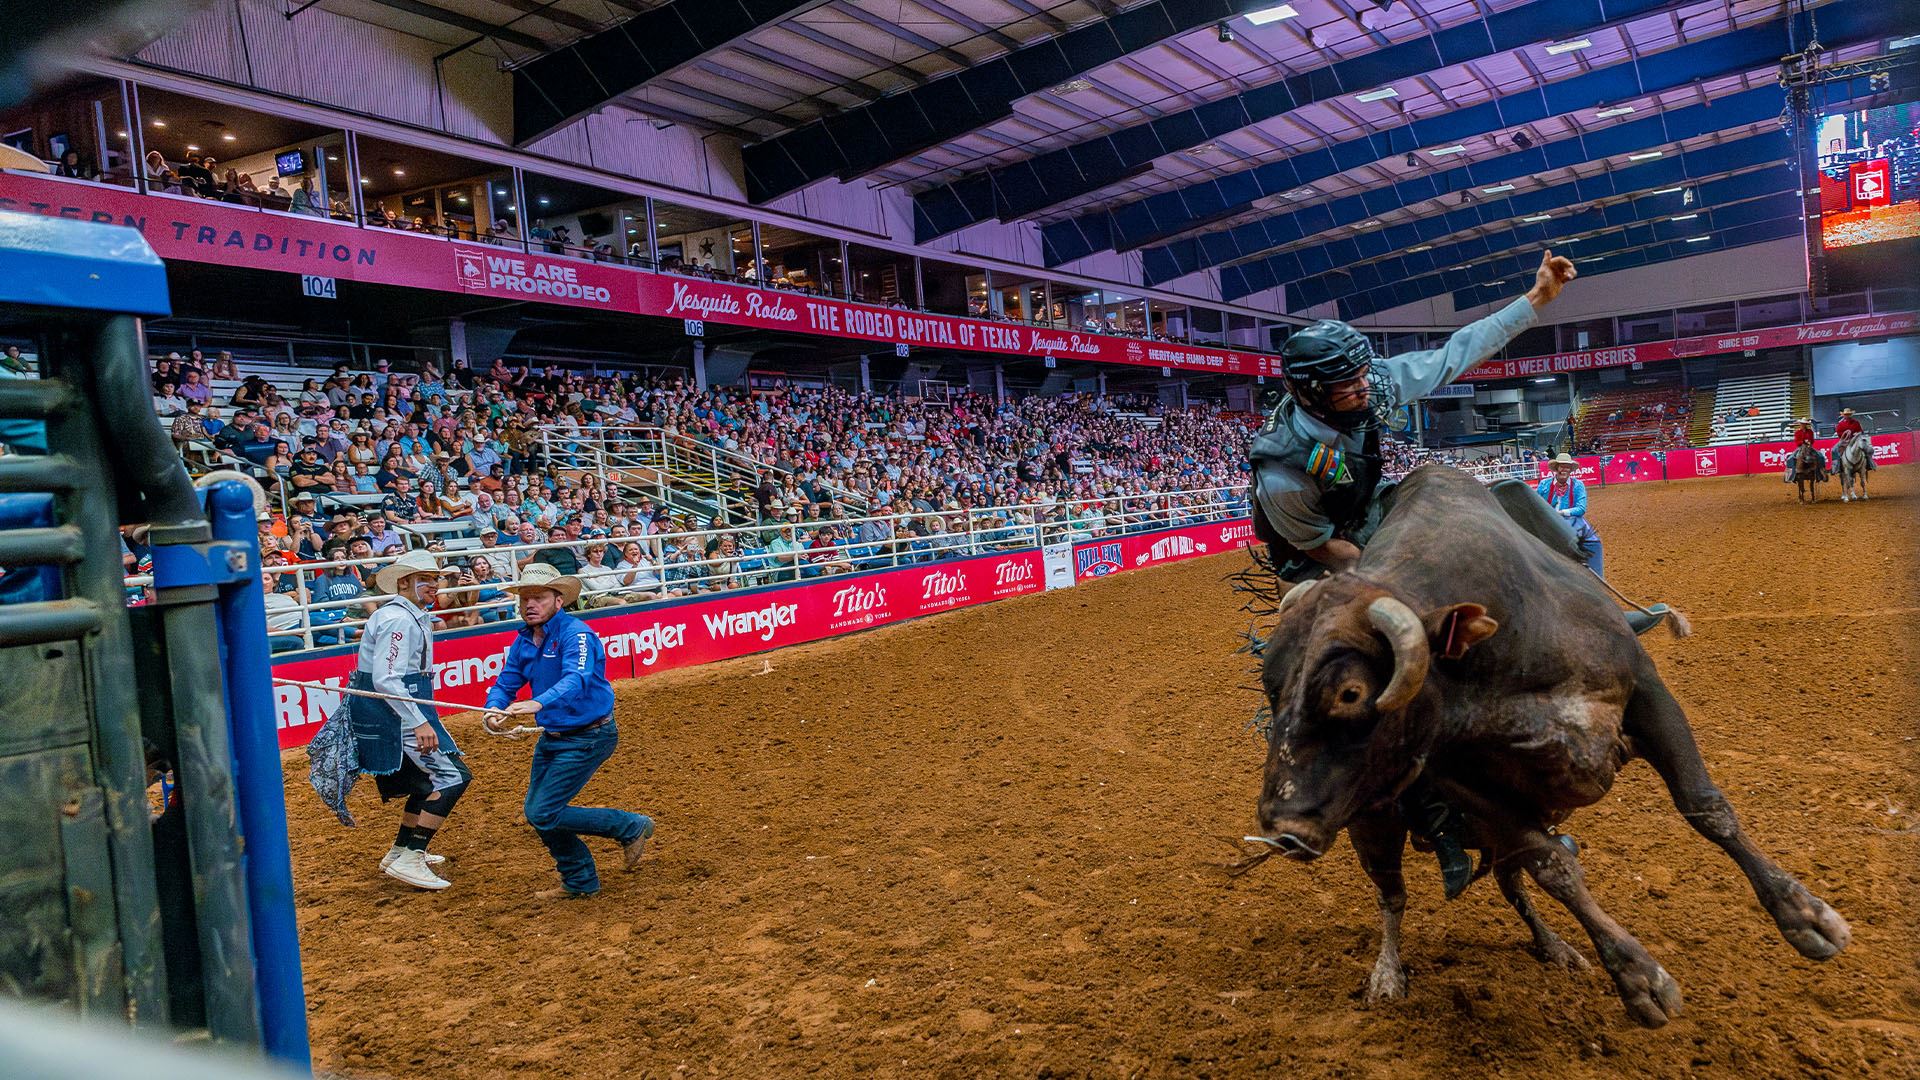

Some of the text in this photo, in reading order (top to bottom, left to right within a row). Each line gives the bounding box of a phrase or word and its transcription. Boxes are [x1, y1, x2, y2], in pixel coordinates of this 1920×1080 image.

[171, 221, 376, 266] TRADITION
[487, 256, 578, 283] WE ARE
[304, 277, 336, 297] 104
[489, 273, 611, 303] PRORODEO
[666, 282, 741, 318] Mesquite
[745, 292, 798, 321] Rodeo
[806, 302, 840, 331] THE
[844, 308, 894, 338] RODEO
[898, 316, 957, 345] CAPITAL
[959, 323, 976, 346] OF
[980, 326, 1021, 350] TEXAS
[1028, 330, 1068, 355] Mesquite
[1070, 335, 1100, 354] Rodeo
[686, 320, 703, 336] 106
[1796, 326, 1833, 340] Where
[1837, 317, 1887, 338] Legends
[1718, 335, 1759, 349] SINCE 1957
[1148, 349, 1185, 366] HERITAGE
[1186, 353, 1206, 365] RUNS
[1206, 355, 1224, 366] DEEP
[1505, 362, 1516, 376] 13
[1518, 357, 1551, 374] WEEK
[1554, 352, 1592, 371] RODEO
[1595, 347, 1636, 366] SERIES
[1077, 546, 1101, 577] BILL
[702, 602, 798, 642] Wrangler
[830, 617, 865, 629] HANDMADE
[597, 622, 686, 666] rangler
